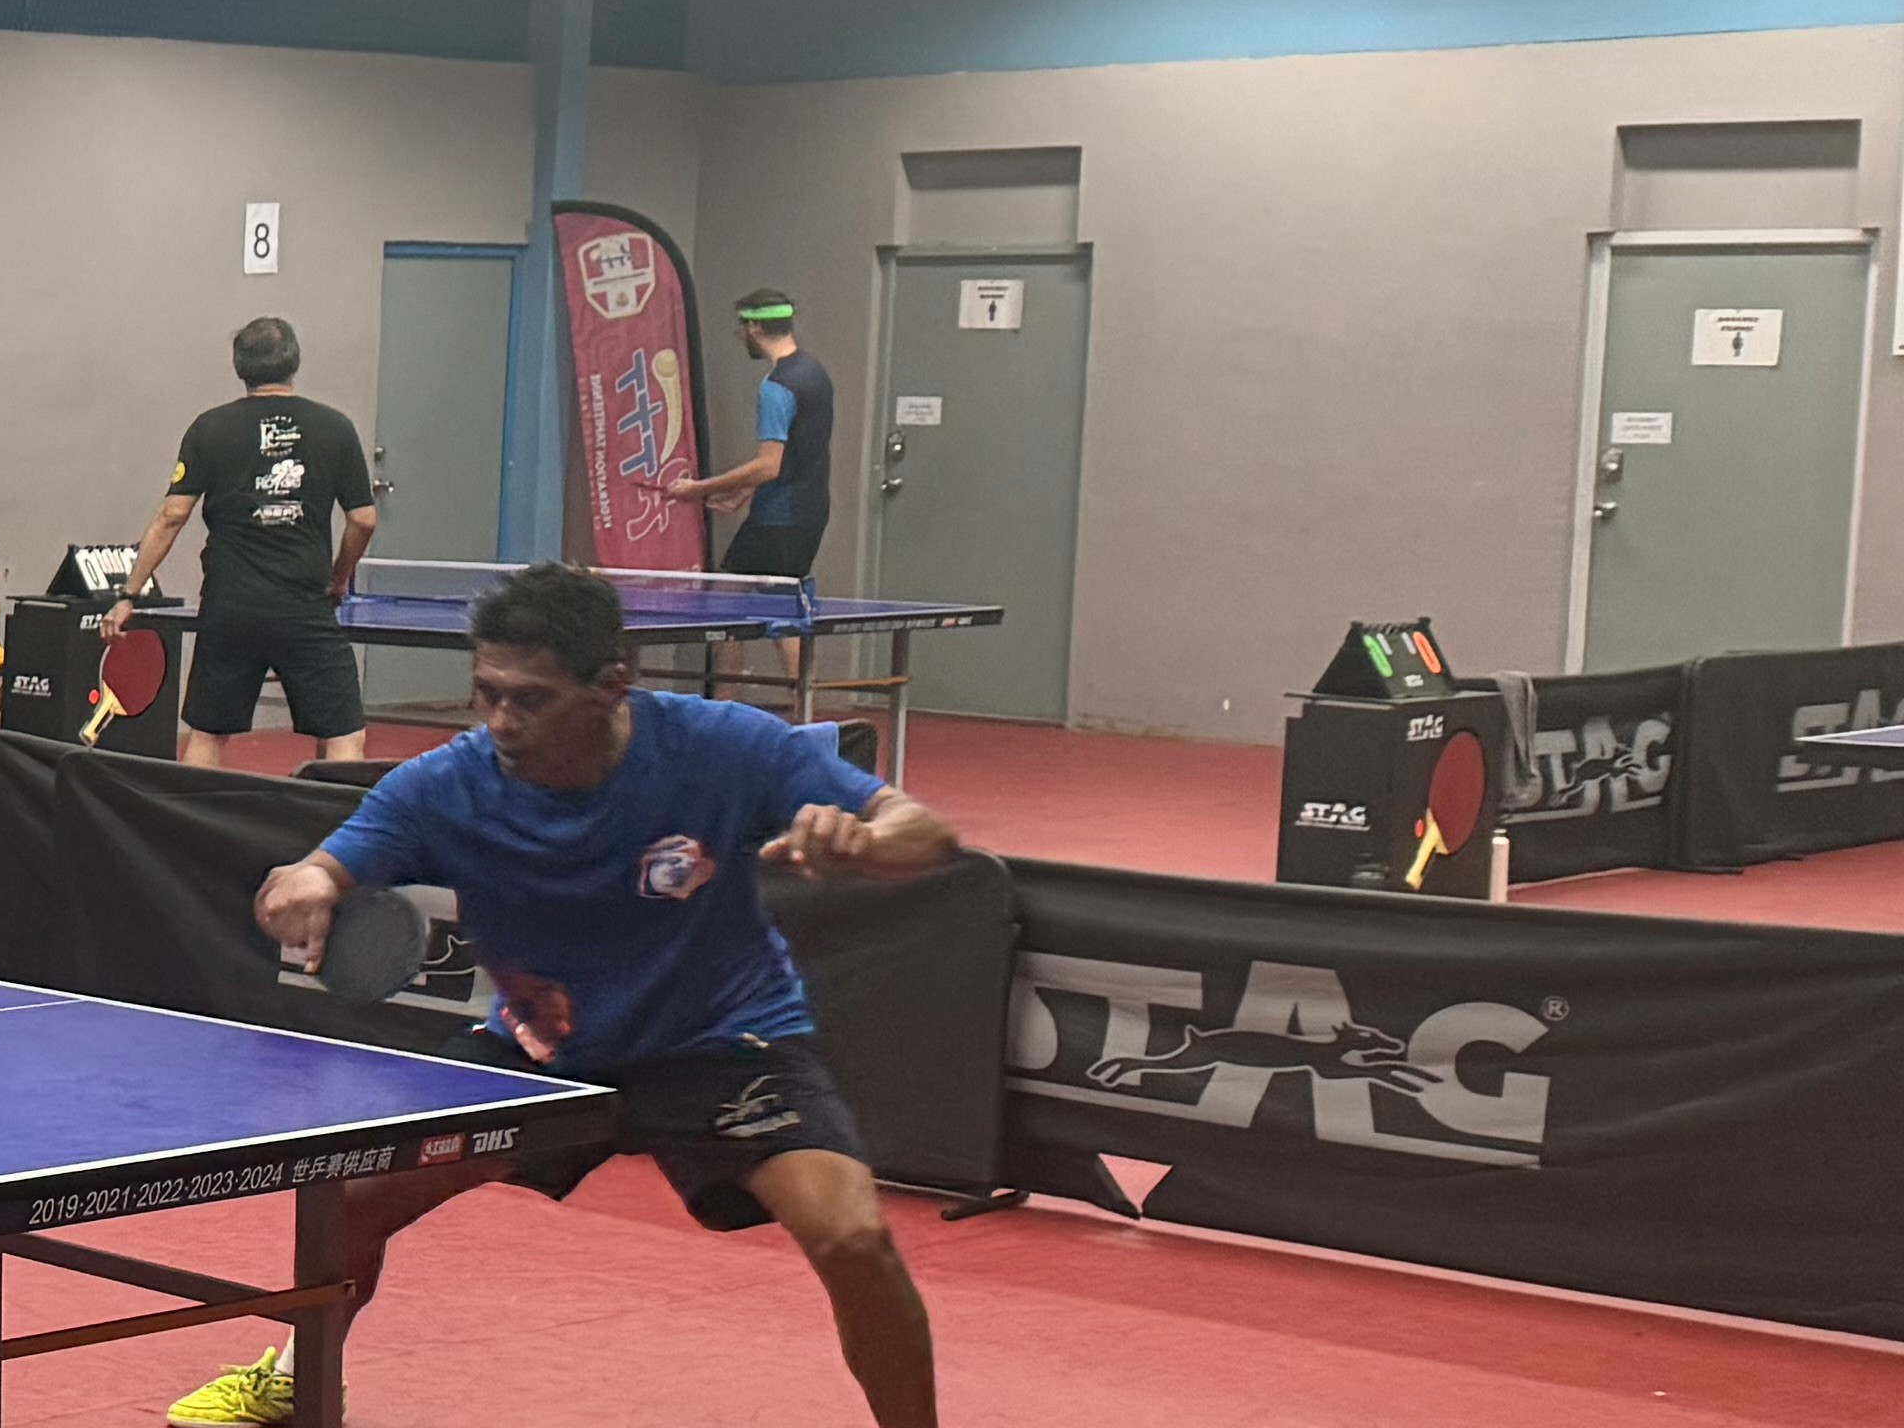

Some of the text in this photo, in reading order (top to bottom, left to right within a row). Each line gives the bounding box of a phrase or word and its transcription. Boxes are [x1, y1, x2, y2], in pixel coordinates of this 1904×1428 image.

[254, 223, 270, 259] 8
[1299, 802, 1367, 823] STAG
[472, 1127, 520, 1154] DHS
